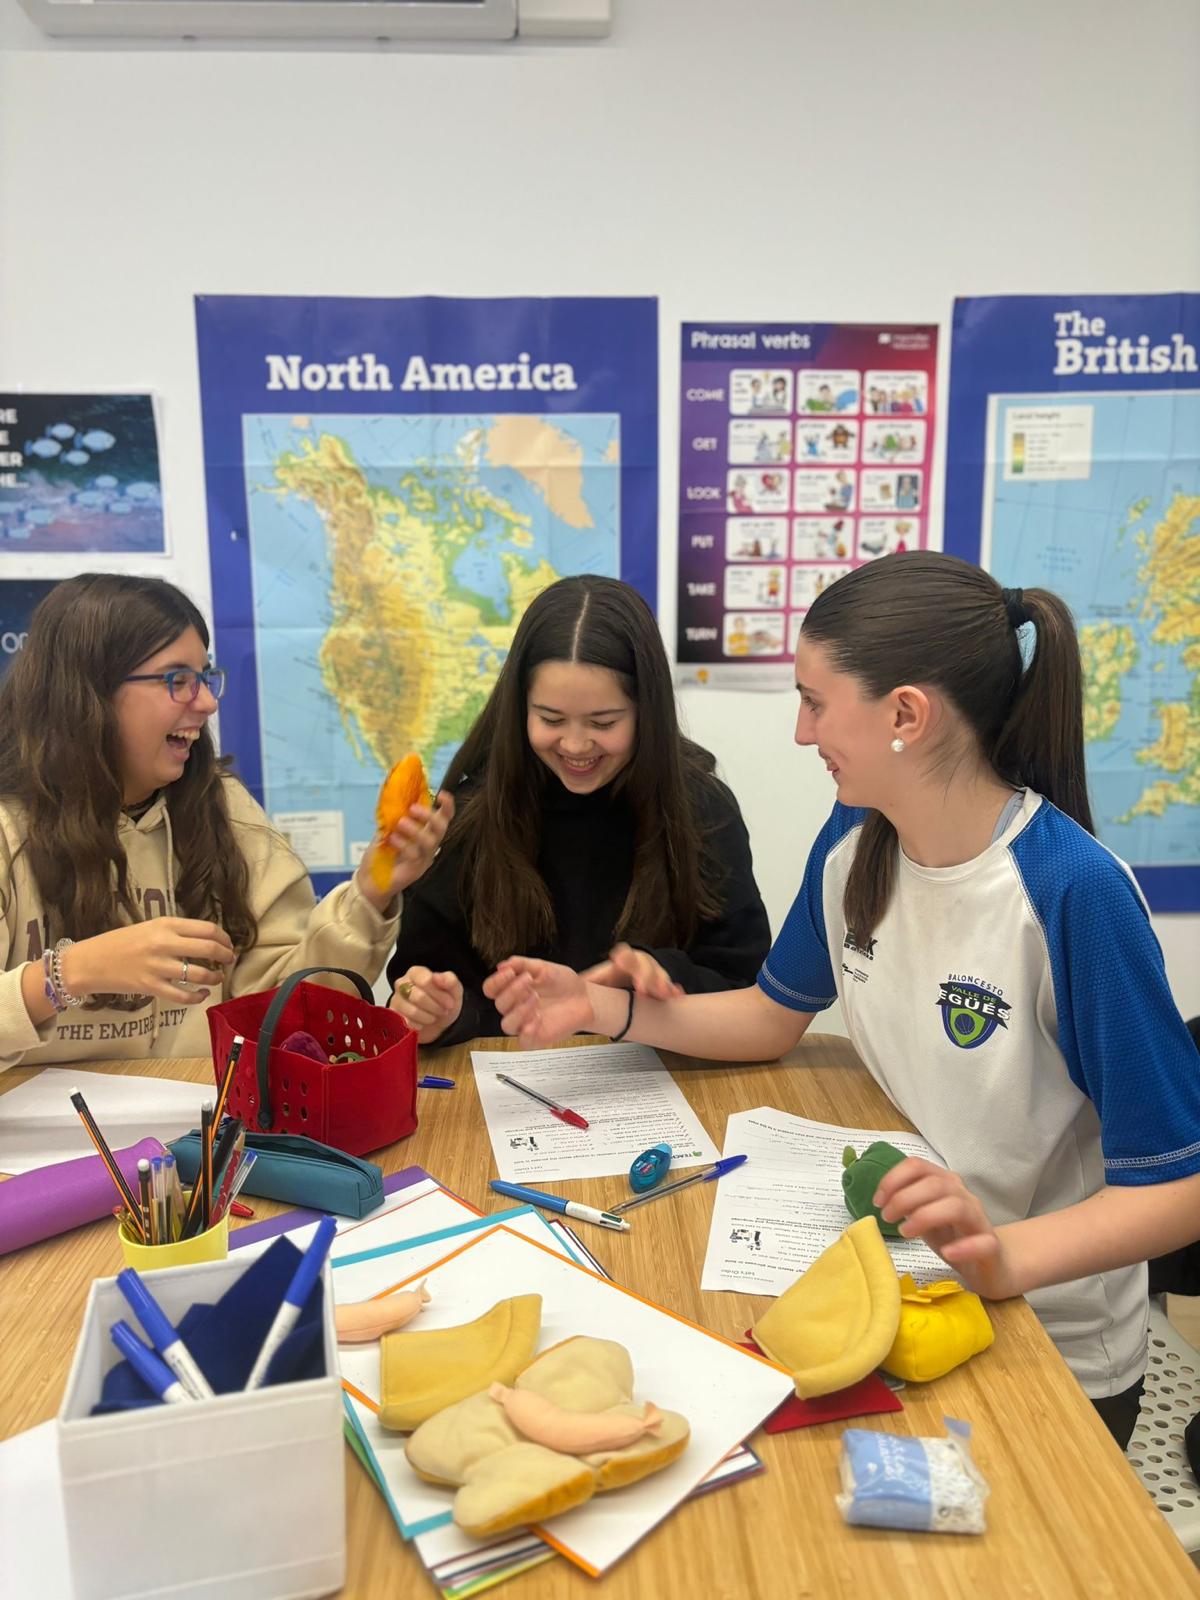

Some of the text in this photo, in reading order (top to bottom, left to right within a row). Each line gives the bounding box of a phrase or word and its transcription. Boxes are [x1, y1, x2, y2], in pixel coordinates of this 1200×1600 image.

[1053, 310, 1105, 336] The
[690, 331, 810, 349] Phrasal verbs
[1053, 333, 1199, 375] British
[264, 353, 578, 391] North America
[687, 388, 724, 401] COME
[692, 437, 717, 451] GET
[687, 486, 721, 499] LOOK
[690, 535, 714, 548] PUT
[687, 582, 717, 596] TAKE
[686, 627, 717, 641] TURN
[947, 973, 1003, 996] BALONCESTO
[951, 984, 979, 997] VALLE
[938, 989, 1010, 1020] EGÜÉS
[56, 1008, 188, 1041] THE EMPIRE CITY
